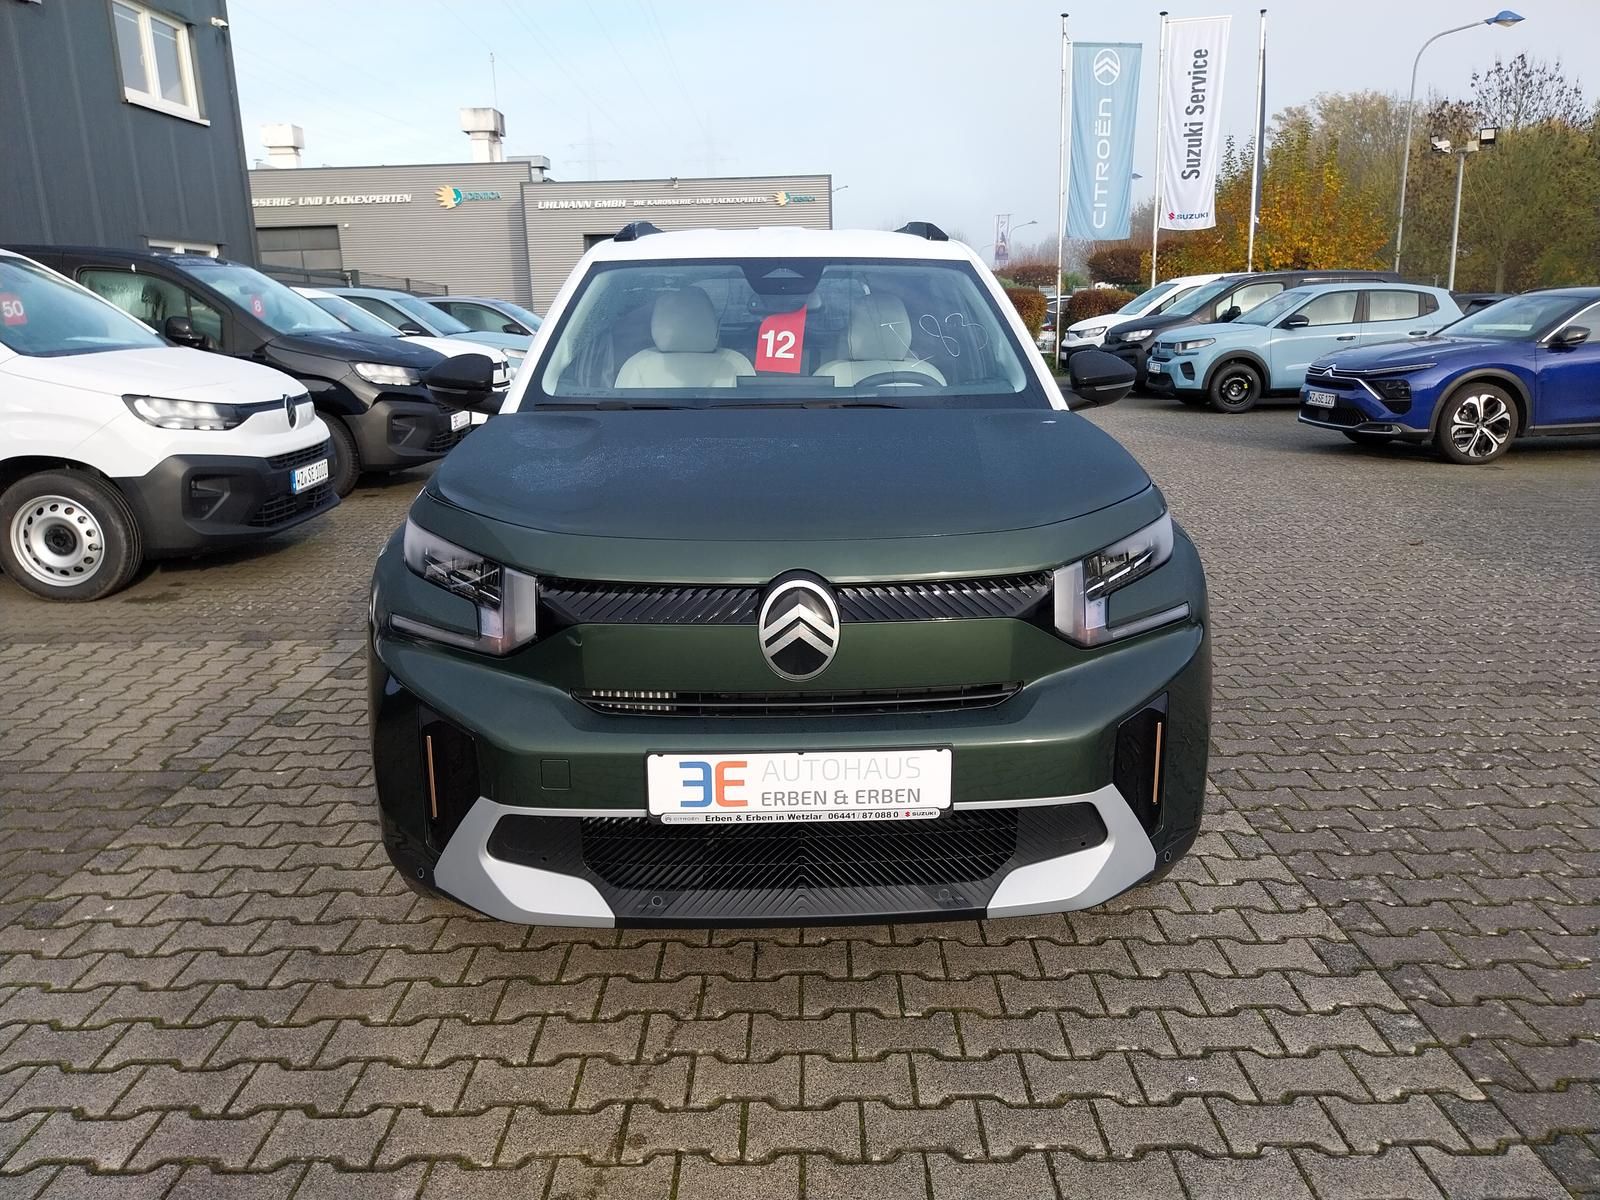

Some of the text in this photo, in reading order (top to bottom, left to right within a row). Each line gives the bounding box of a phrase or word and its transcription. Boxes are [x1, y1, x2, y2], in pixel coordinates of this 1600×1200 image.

[1181, 49, 1209, 180] Suzuki Service
[299, 196, 323, 206] UND
[325, 194, 412, 205] LACKEXPERTEN
[538, 199, 592, 209] UHLMANN
[594, 199, 627, 208] GMBH
[1176, 212, 1209, 220] SUZUKI
[2, 300, 24, 317] 50
[254, 299, 262, 313] 8
[761, 329, 796, 359] 12
[762, 756, 921, 783] AUTOHAUS
[761, 788, 921, 807] ERBEN & ERBEN
[705, 814, 732, 822] Erben
[735, 814, 742, 822] &
[746, 813, 773, 822] Erben
[776, 813, 784, 821] in
[787, 812, 823, 821] Wetzlar
